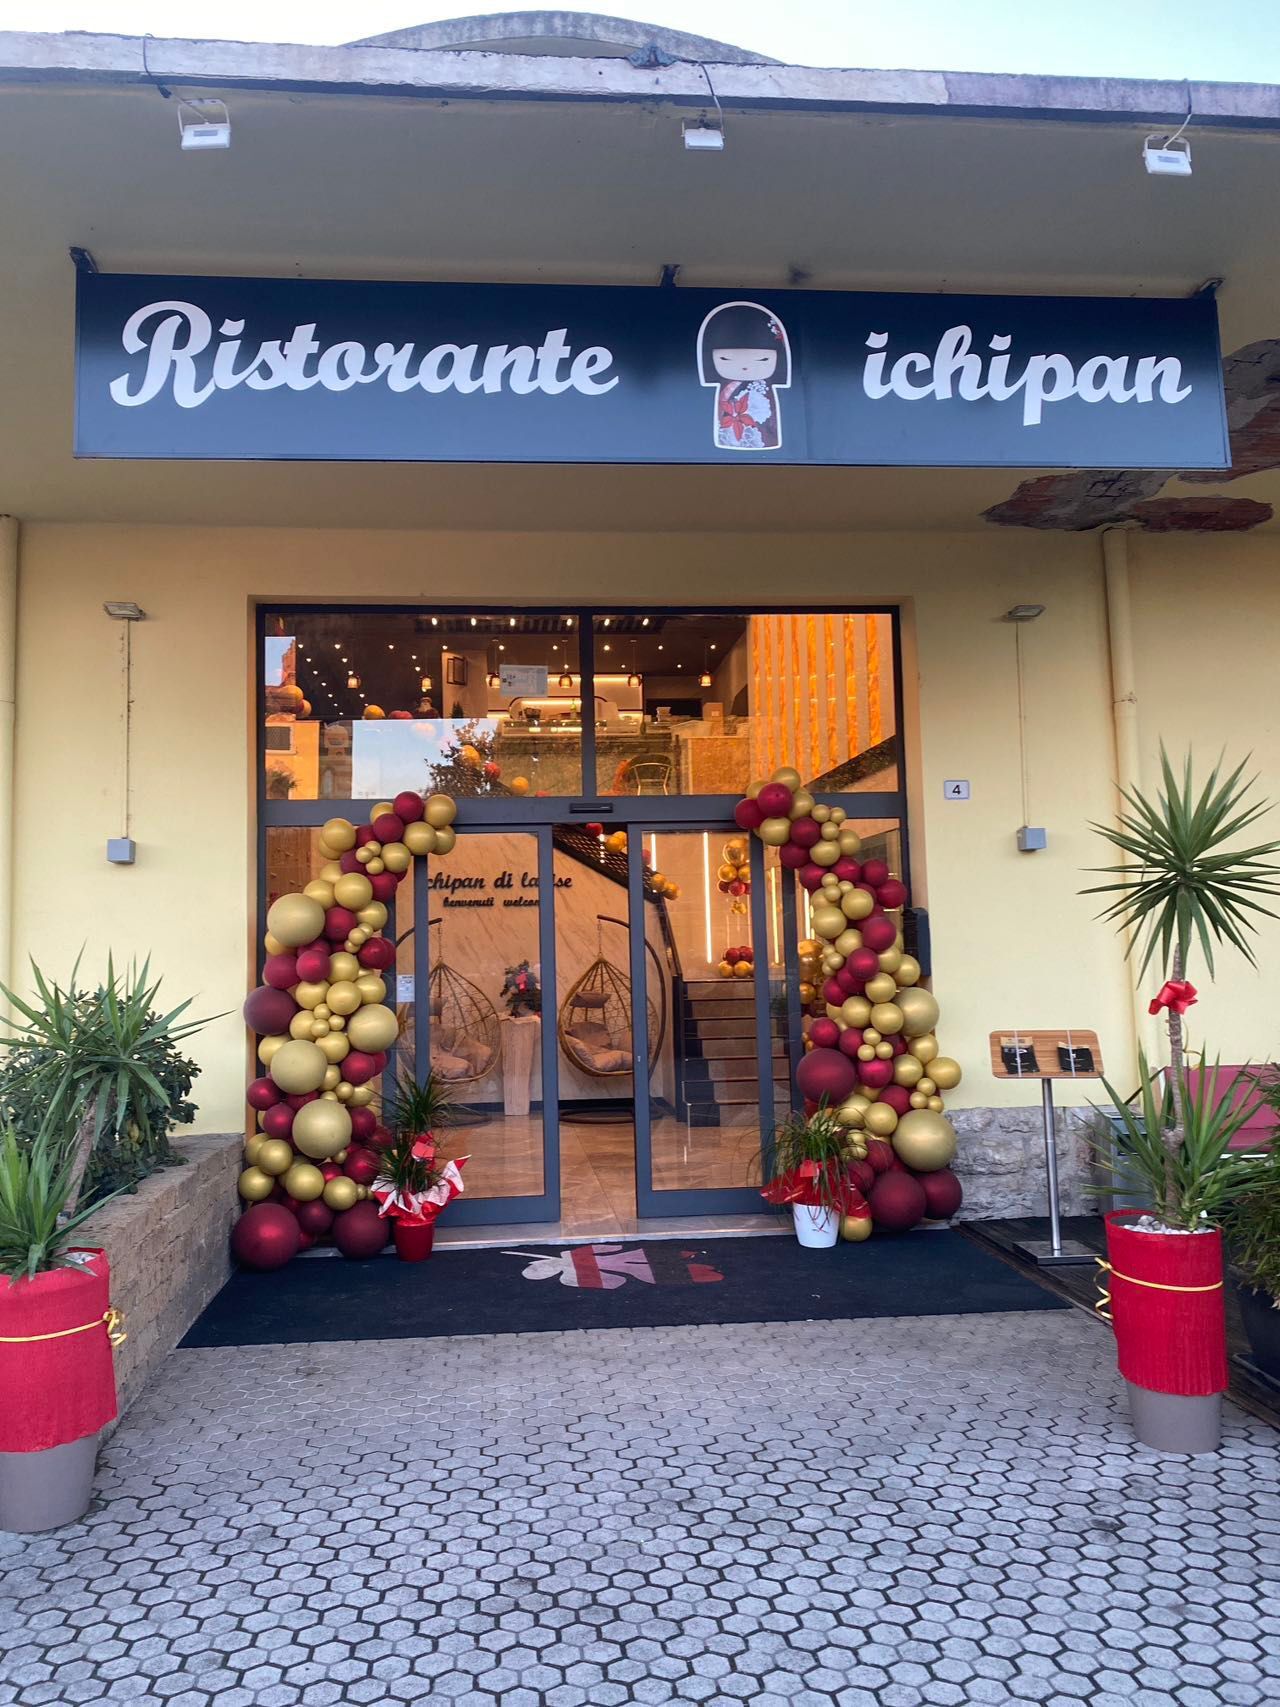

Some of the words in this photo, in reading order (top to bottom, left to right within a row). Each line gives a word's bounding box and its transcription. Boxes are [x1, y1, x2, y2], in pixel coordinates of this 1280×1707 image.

[109, 300, 619, 409] Ristorante
[862, 324, 1193, 426] ichipan
[952, 784, 962, 795] 4
[427, 871, 486, 895] chipan
[493, 870, 514, 888] di
[521, 871, 573, 888] laise
[443, 896, 495, 907] benvenuti
